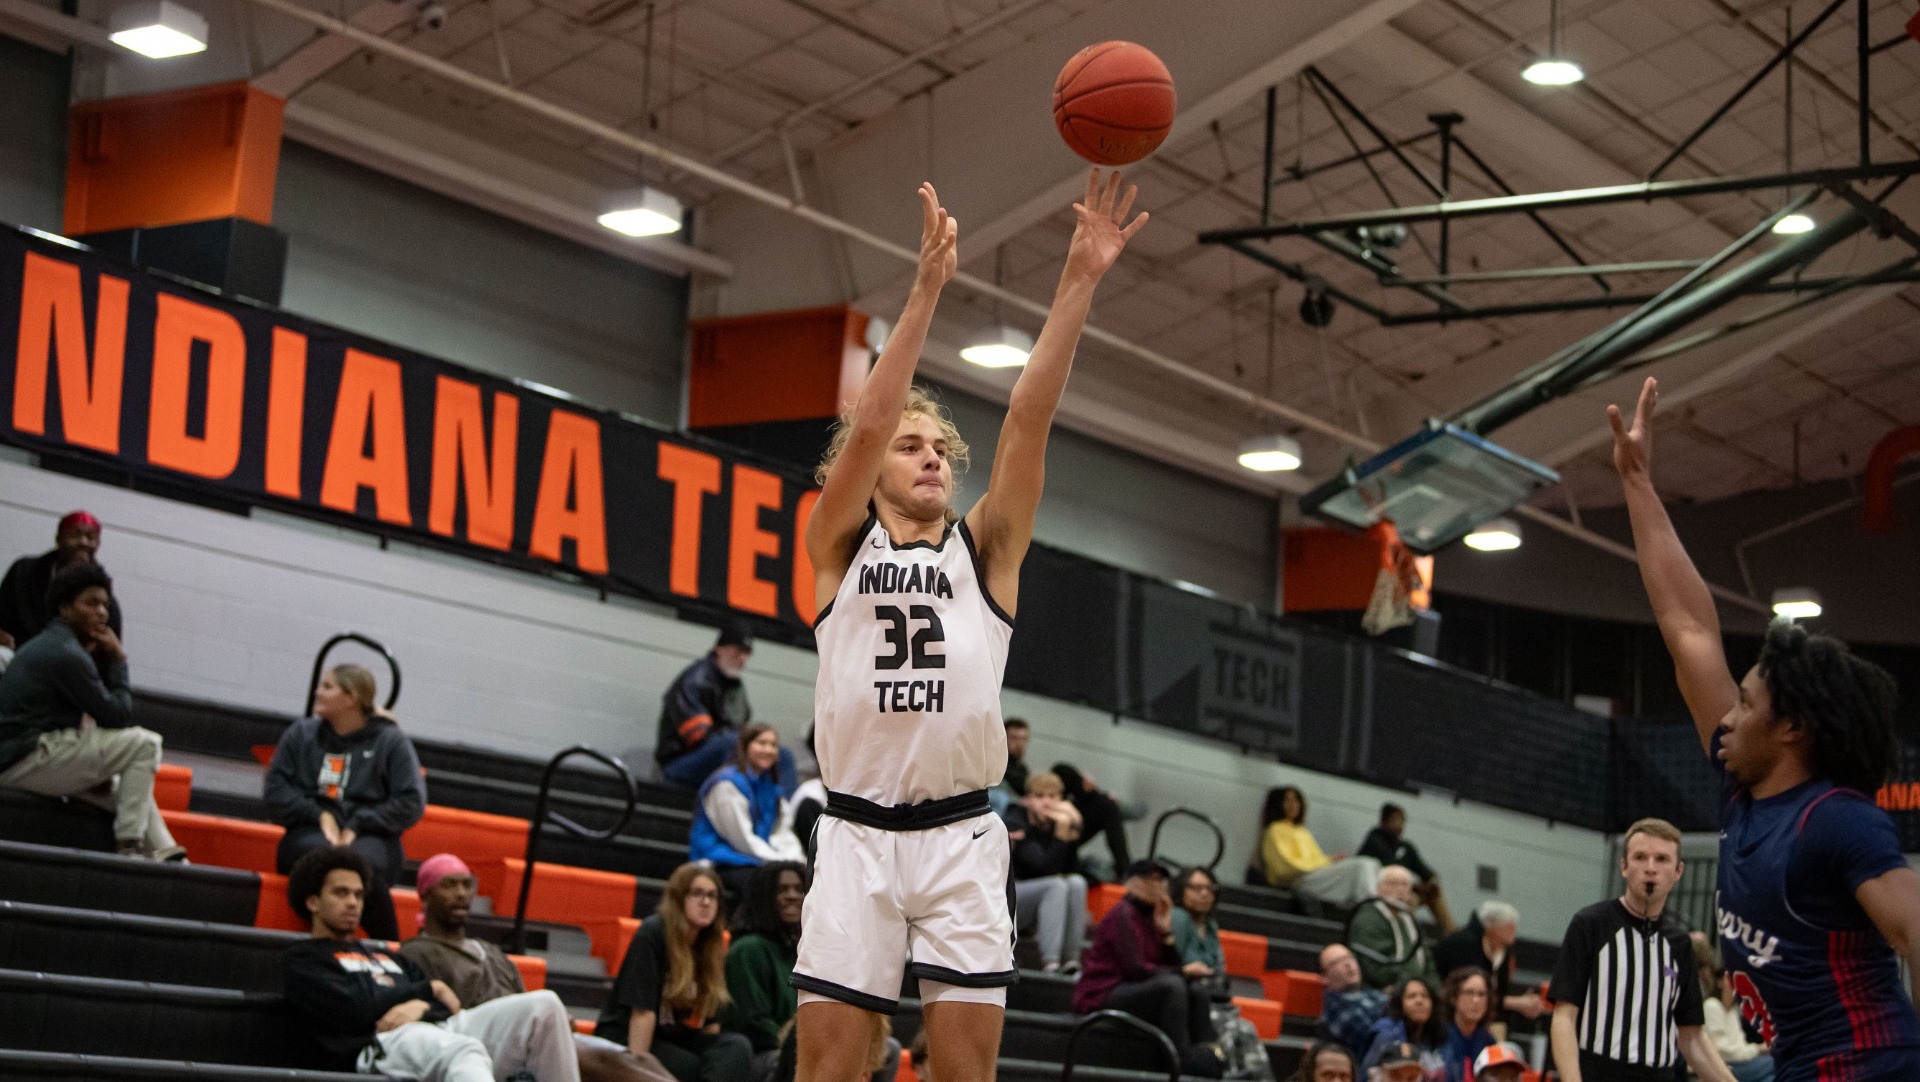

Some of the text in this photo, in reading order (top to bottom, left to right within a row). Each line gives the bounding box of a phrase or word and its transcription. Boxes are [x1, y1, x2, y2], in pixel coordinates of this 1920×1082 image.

[12, 251, 608, 575] NDIANA
[858, 562, 954, 600] INDIANA
[874, 604, 946, 670] 32
[873, 680, 945, 713] TECH
[1213, 645, 1290, 712] TECH
